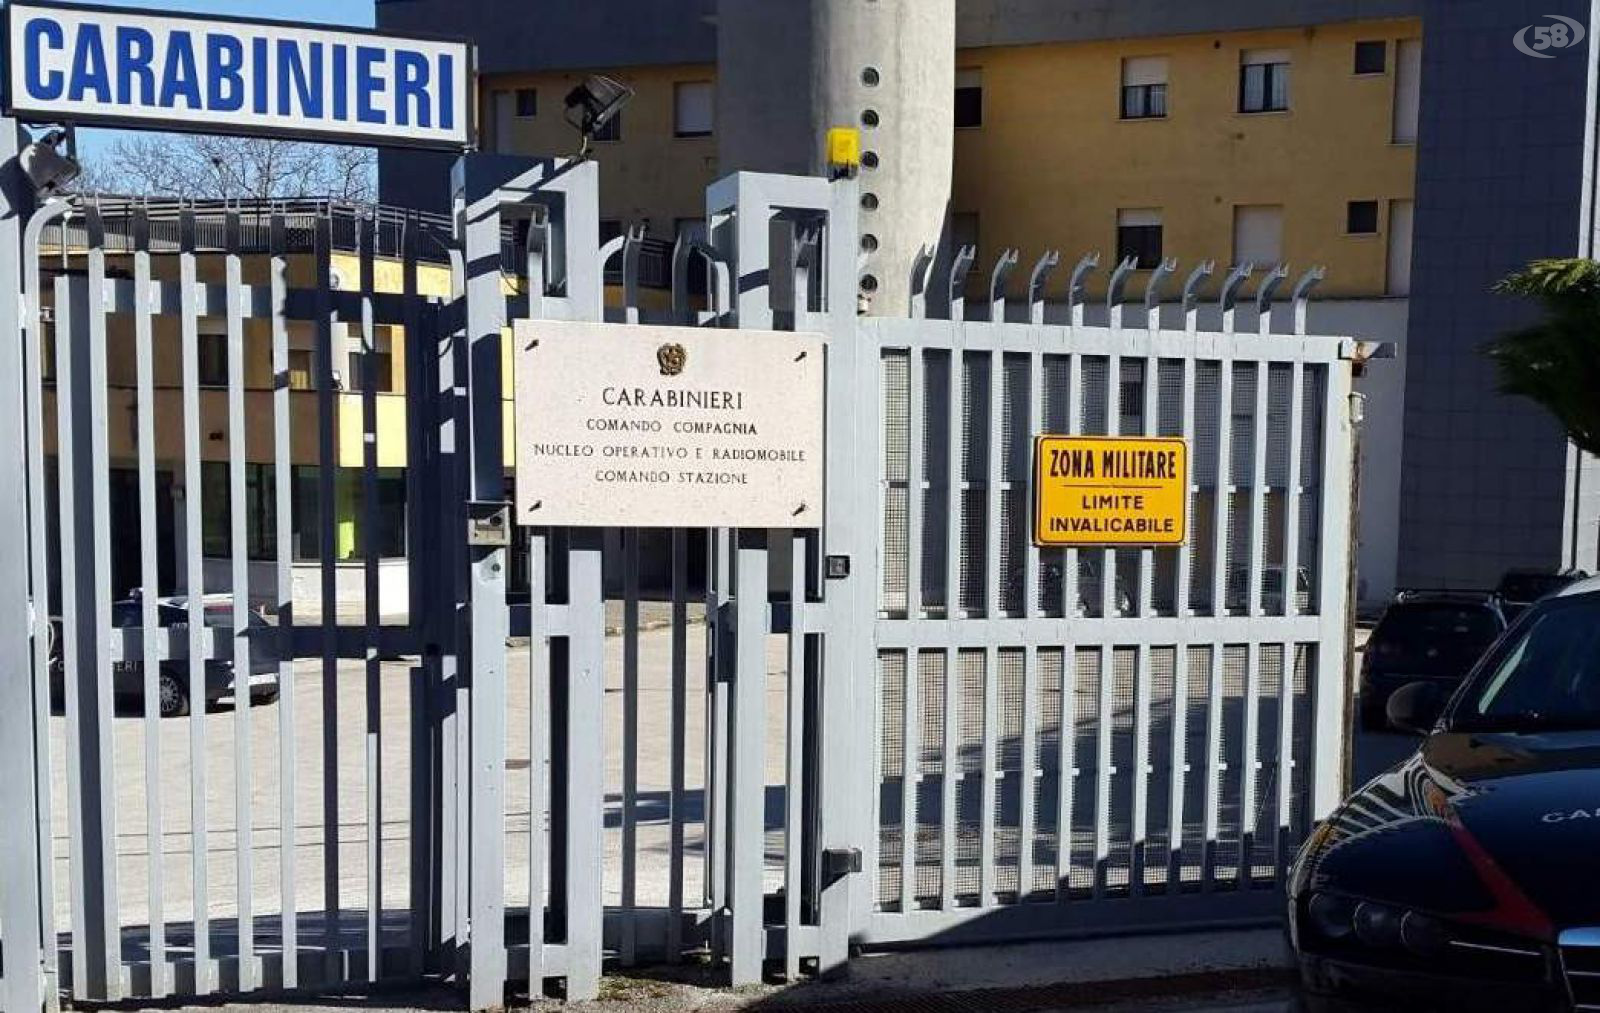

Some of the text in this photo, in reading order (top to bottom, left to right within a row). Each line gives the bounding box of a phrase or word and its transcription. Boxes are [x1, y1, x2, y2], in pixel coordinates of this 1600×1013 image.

[24, 17, 454, 131] CARABINIERI
[602, 387, 742, 410] CARABINIERI
[587, 418, 757, 435] COMANDO COMPAGNIA
[534, 443, 806, 462] NUCLEO OPERATIVO E RADIOMOBILE
[1050, 449, 1177, 480] ZONA MILITARE
[595, 470, 748, 485] COMANDO STAZIONE
[1082, 495, 1145, 510] LIMITE
[1050, 517, 1174, 532] INVALICABILE
[1542, 808, 1600, 823] CA
